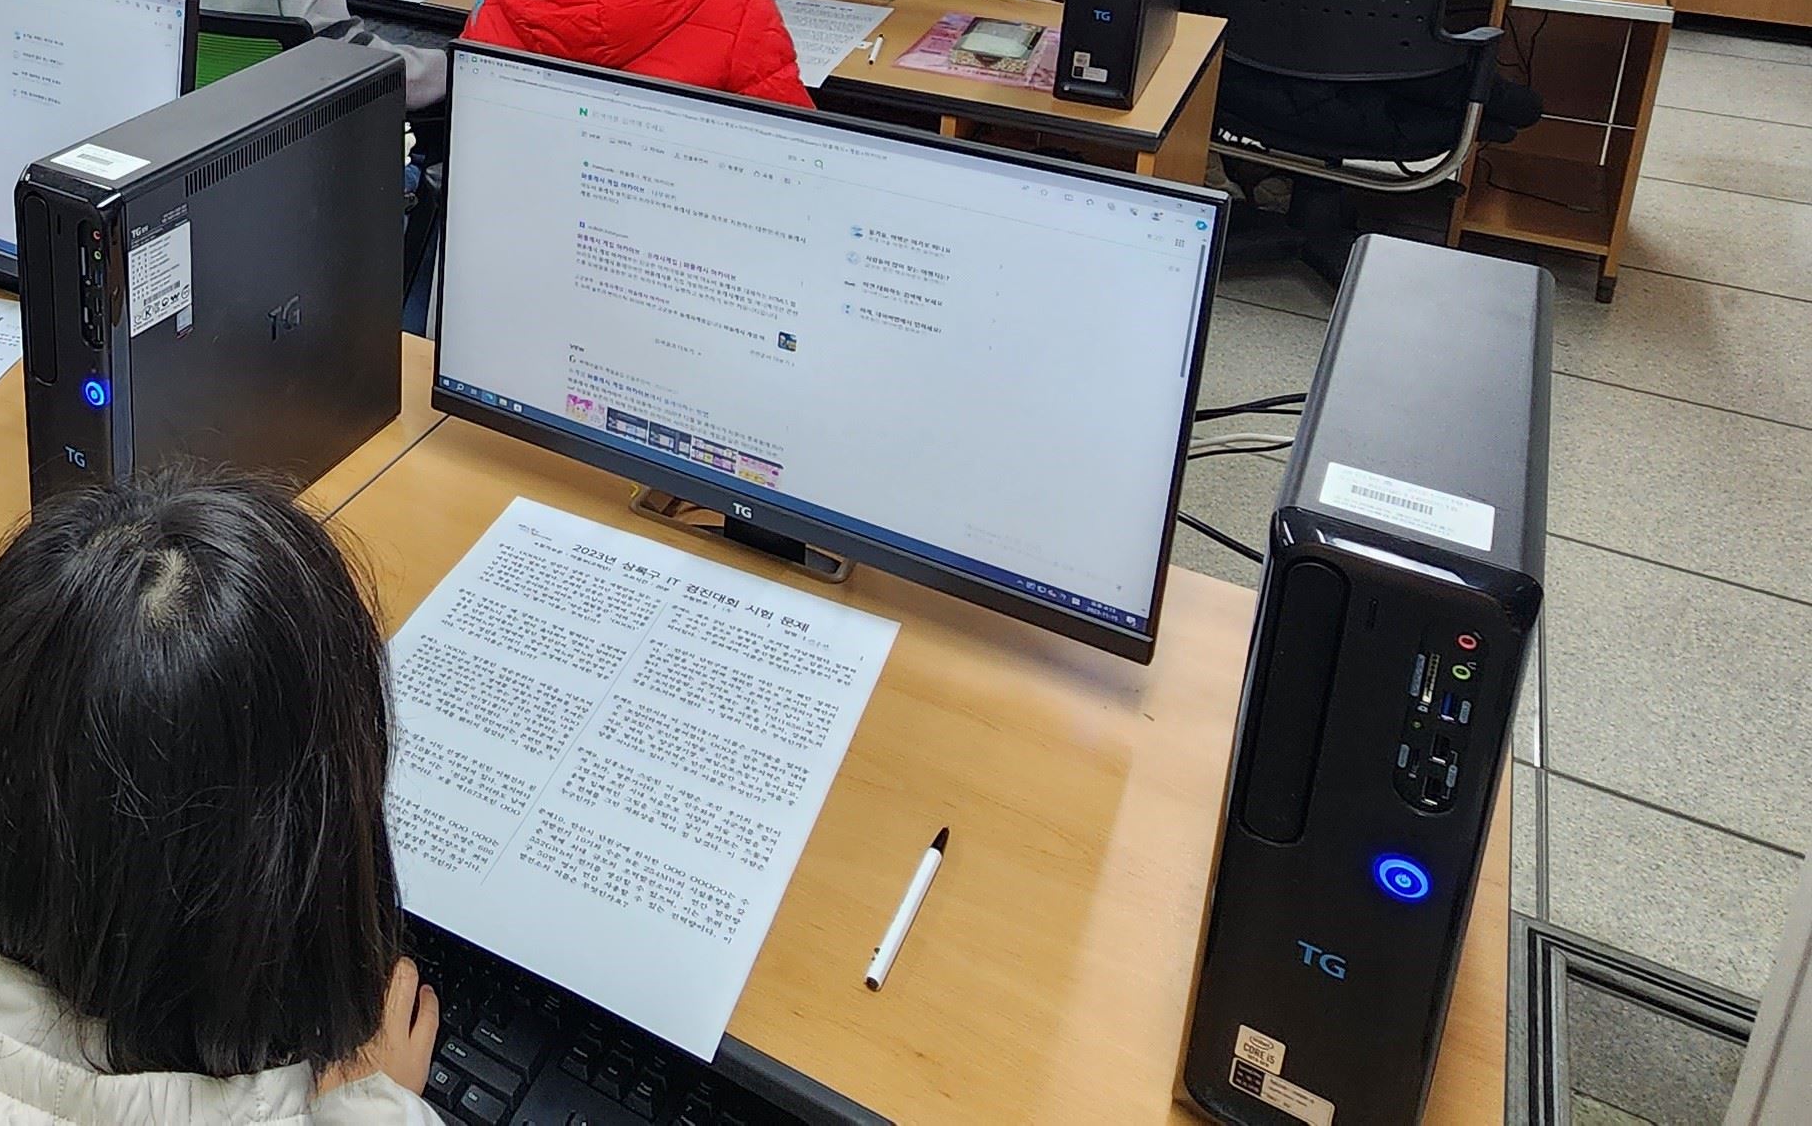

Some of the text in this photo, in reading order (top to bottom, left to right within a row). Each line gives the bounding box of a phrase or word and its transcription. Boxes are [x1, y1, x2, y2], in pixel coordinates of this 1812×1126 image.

[1093, 9, 1111, 22] TG
[267, 296, 302, 342] TG
[64, 446, 86, 468] TG
[732, 503, 753, 520] TG
[570, 543, 810, 633] 2023년 상록구 IT 경진대회 시험 문제
[1295, 938, 1347, 982] TG
[1244, 1042, 1266, 1060] CORE
